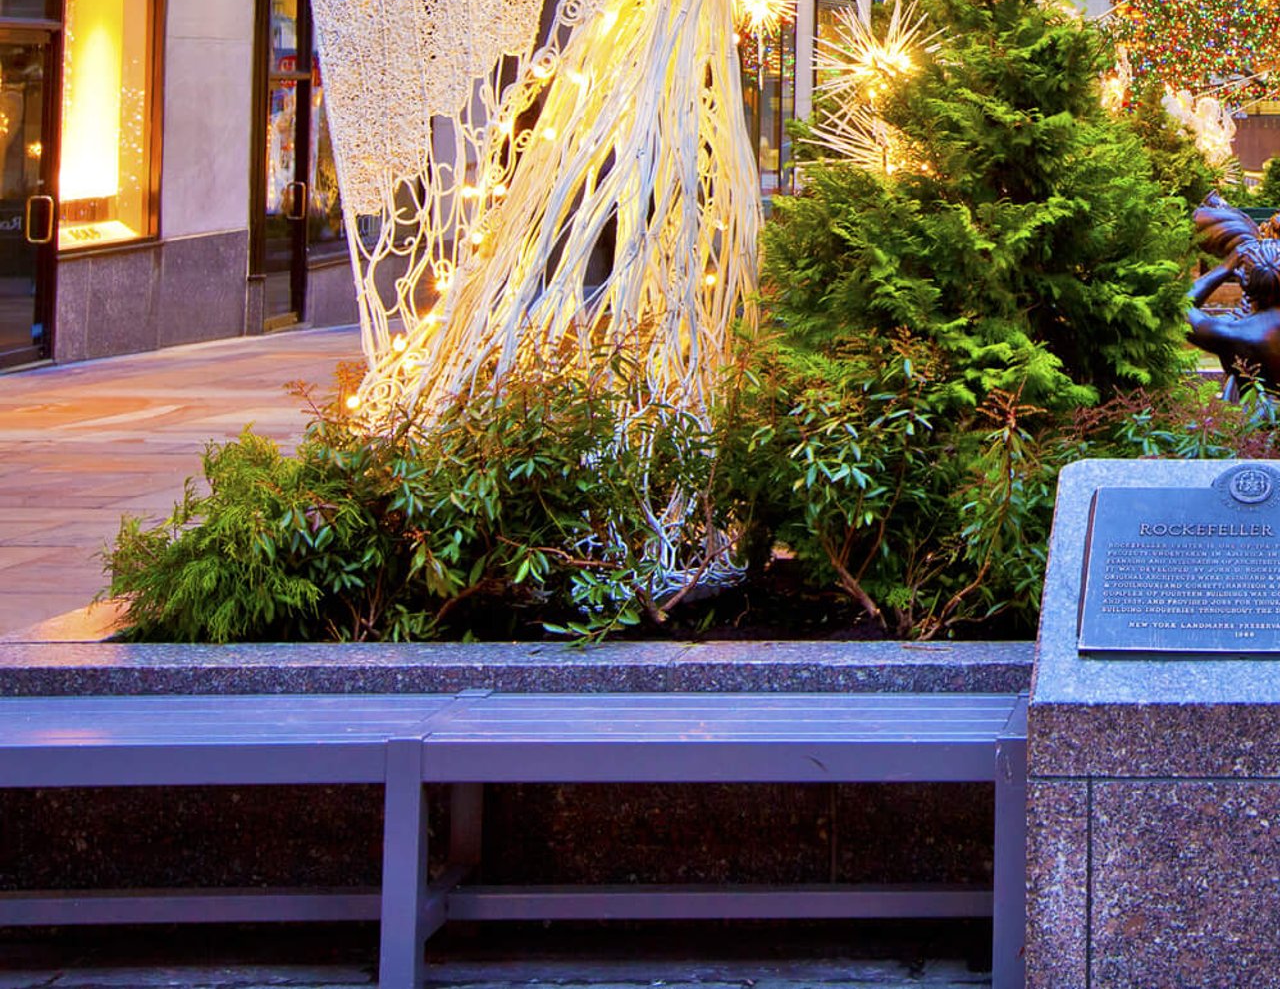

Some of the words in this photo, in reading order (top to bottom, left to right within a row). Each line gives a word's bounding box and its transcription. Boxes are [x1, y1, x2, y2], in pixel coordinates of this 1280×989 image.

[1139, 523, 1274, 537] ROCKEFELLER
[1128, 621, 1148, 630] NEW
[1151, 622, 1177, 630] YORK
[1180, 622, 1235, 630] LANDMARKS
